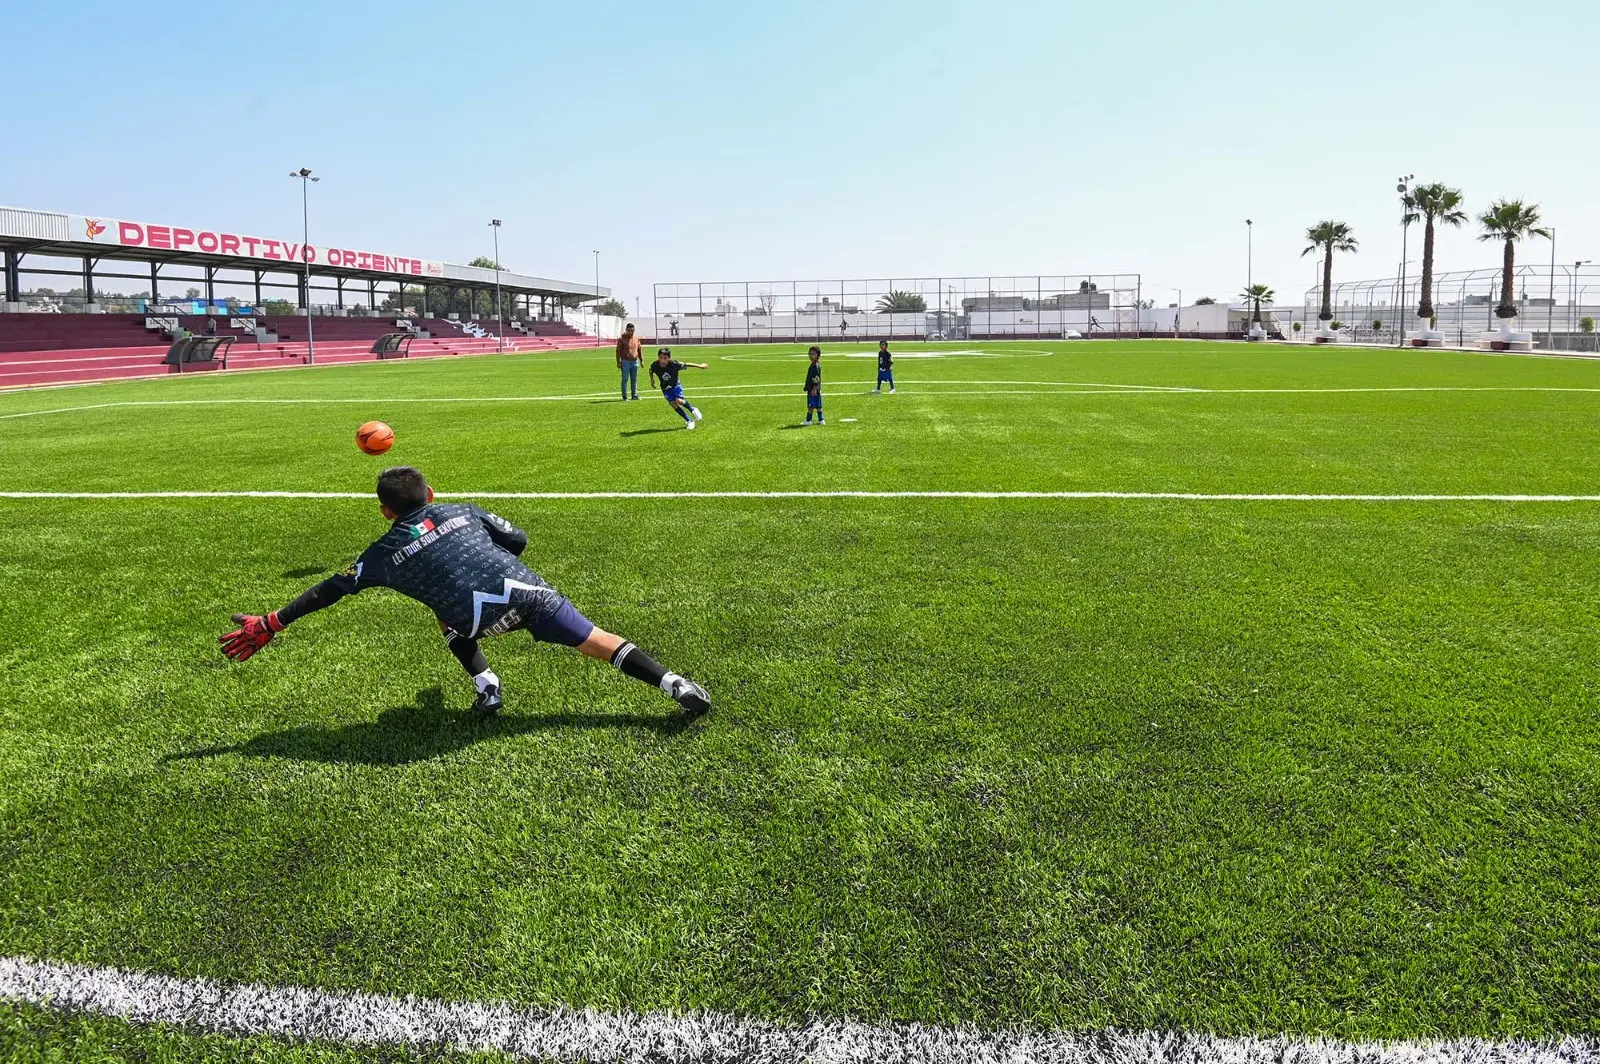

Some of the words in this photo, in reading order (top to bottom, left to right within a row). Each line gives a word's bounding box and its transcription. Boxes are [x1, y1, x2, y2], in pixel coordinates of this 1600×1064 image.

[118, 221, 316, 263] DEPORTIVO
[327, 248, 422, 275] ORIENTE
[402, 540, 422, 557] YOUR
[420, 529, 439, 546] SOUL
[437, 515, 470, 535] EXPLORE
